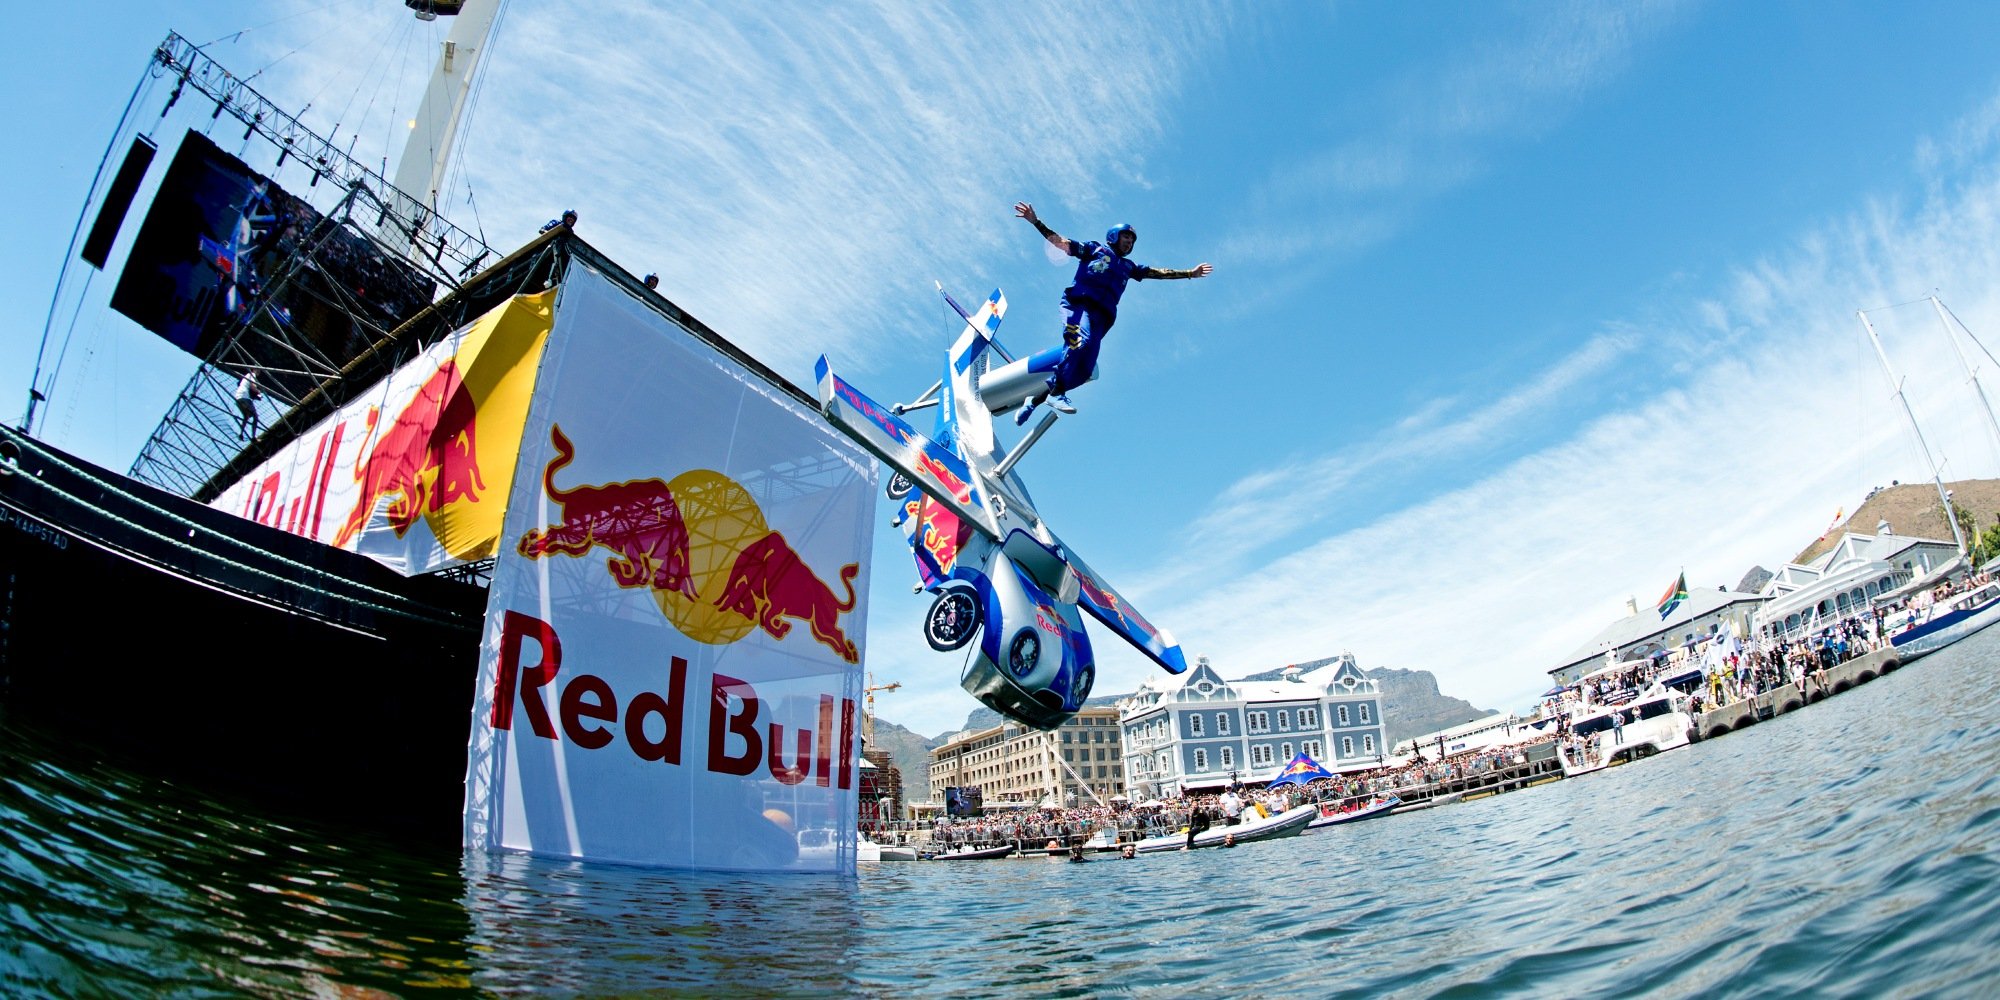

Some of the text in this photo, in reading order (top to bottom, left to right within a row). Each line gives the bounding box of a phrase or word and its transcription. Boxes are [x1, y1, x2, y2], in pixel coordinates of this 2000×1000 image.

[1036, 613, 1062, 637] Red
[491, 610, 853, 790] Red Bull
